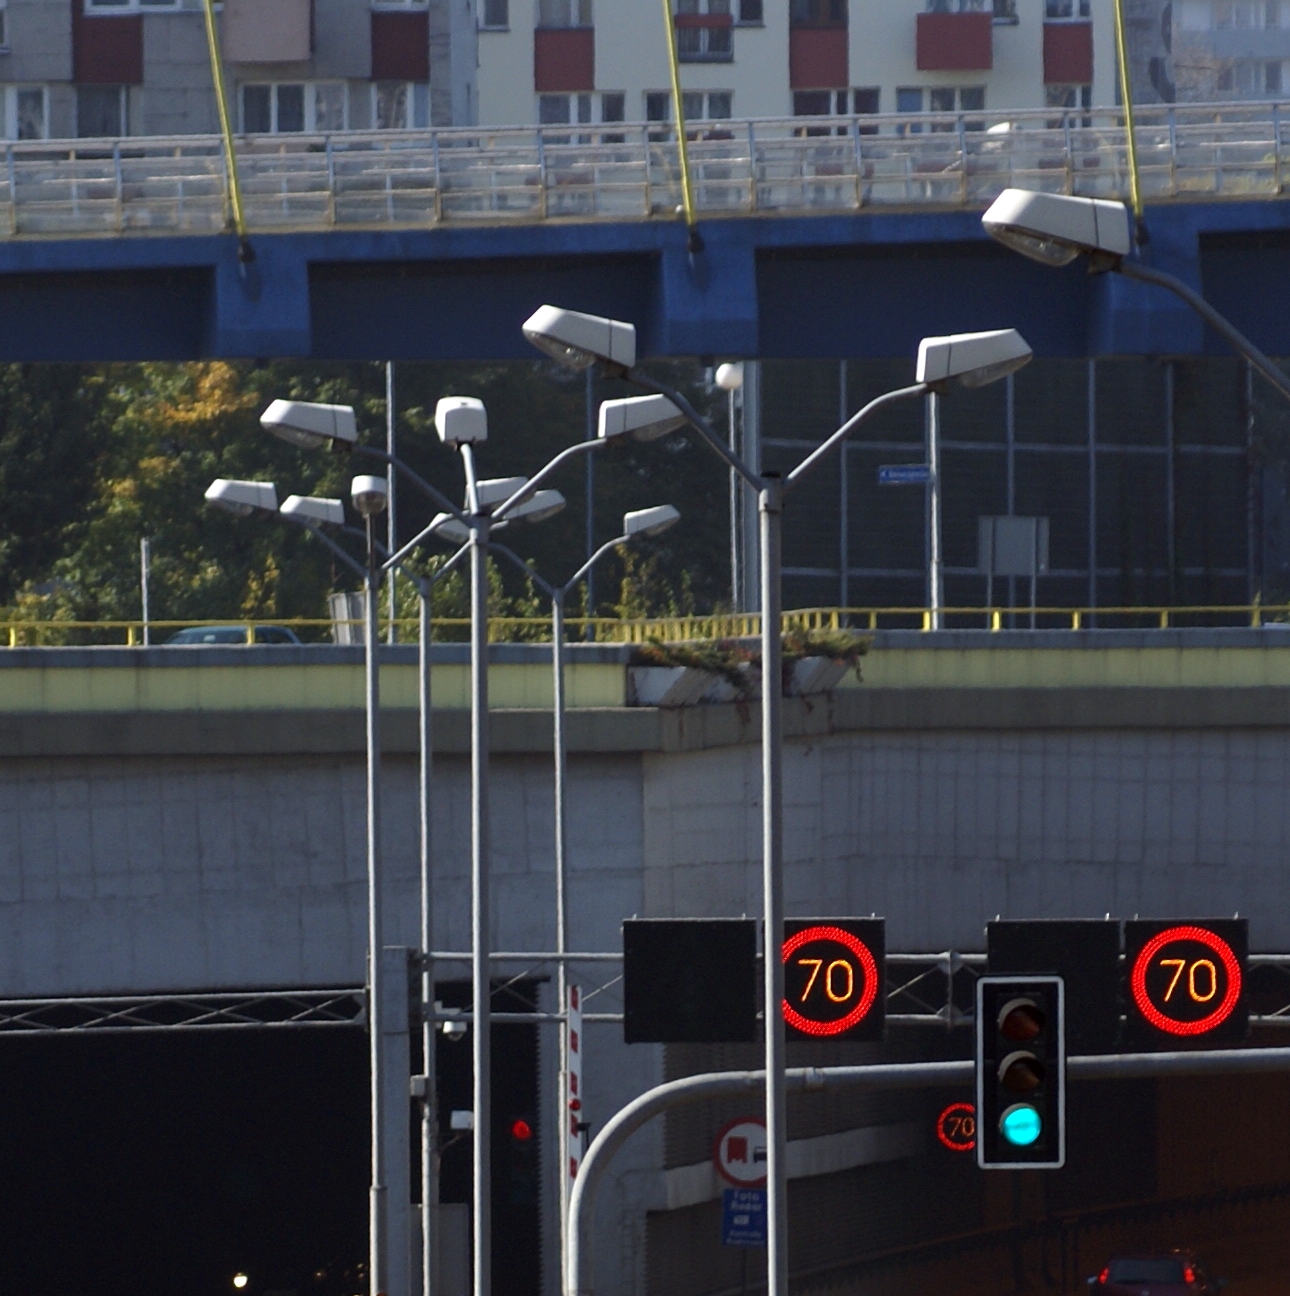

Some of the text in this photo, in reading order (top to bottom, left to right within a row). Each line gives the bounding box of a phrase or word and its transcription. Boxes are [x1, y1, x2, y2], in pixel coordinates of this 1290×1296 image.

[797, 959, 854, 1002] 70
[1160, 959, 1216, 1002] 70
[949, 1117, 975, 1137] 70
